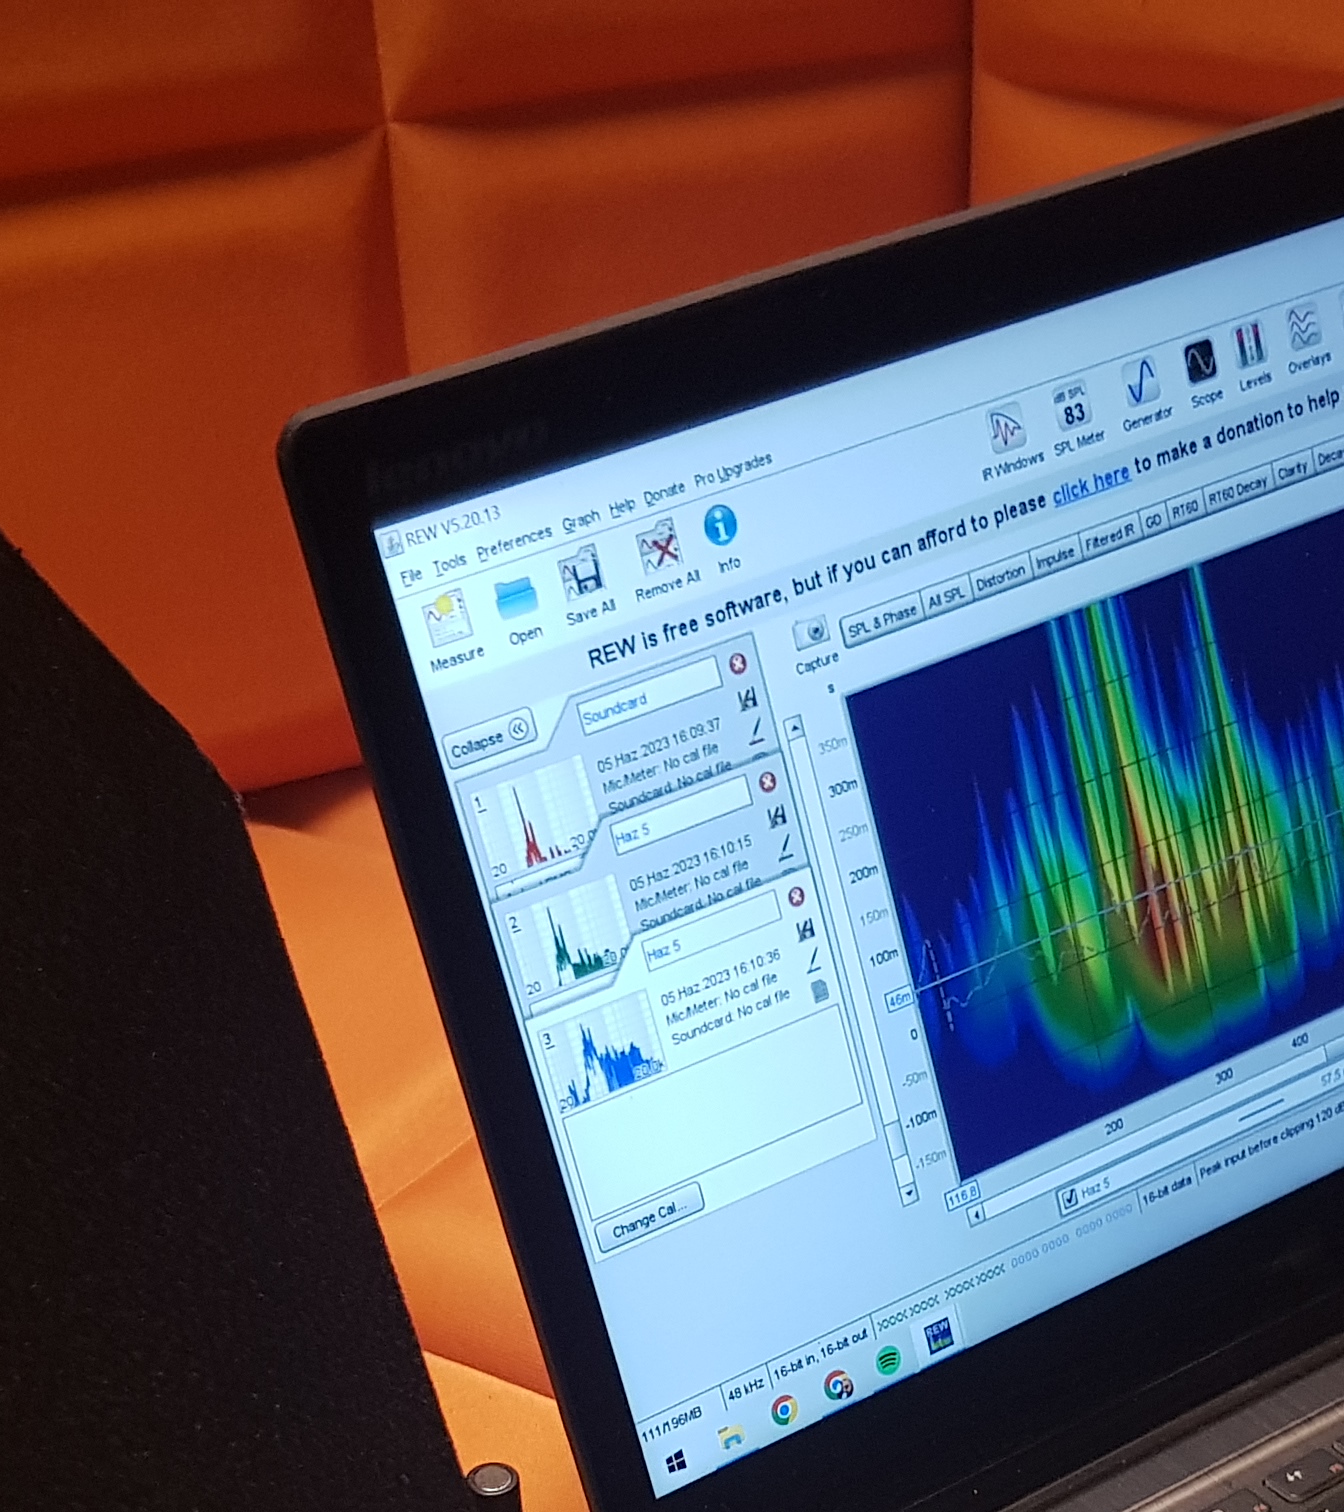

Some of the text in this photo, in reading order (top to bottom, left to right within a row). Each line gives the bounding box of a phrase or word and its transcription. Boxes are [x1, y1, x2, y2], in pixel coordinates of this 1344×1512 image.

[1287, 349, 1332, 377] Overlays
[1238, 369, 1273, 393] Levels
[1190, 386, 1224, 411] Scope
[1062, 401, 1086, 427] 83
[1121, 403, 1174, 433] Generator
[1053, 427, 1106, 457] SPL Meter
[693, 451, 773, 490] Pro Upgrades
[992, 448, 1045, 479] Windows
[1277, 459, 1309, 483] Clarity
[642, 480, 687, 507] Donate
[1207, 473, 1268, 507] RT60 Decay
[561, 508, 601, 534] Graph
[608, 496, 637, 518] Help
[1171, 498, 1199, 520] RT60
[404, 504, 502, 548] REW V5.20.13
[587, 634, 638, 670] REW
[640, 627, 659, 651] is
[661, 612, 700, 643] free
[702, 581, 789, 632] software,
[791, 569, 824, 598] but
[825, 562, 841, 585] if
[842, 553, 878, 584] you
[880, 540, 913, 566] can
[915, 518, 967, 554] afford
[969, 510, 990, 534] to
[992, 491, 1048, 530] please
[1050, 474, 1091, 508] click
[1091, 460, 1131, 494] here
[1133, 453, 1152, 475] to
[1155, 436, 1198, 467] make
[1202, 435, 1213, 451] a
[1214, 406, 1284, 446] donation
[1286, 399, 1304, 421] to
[1306, 386, 1341, 417] help
[1084, 526, 1123, 553] Filtered
[476, 524, 553, 562] Preferences
[432, 552, 468, 577] Tools
[717, 555, 742, 575] Info
[1035, 544, 1076, 572] Impulse
[399, 566, 424, 587] File
[634, 569, 701, 604] Remove All
[975, 561, 1027, 593] Distortion
[926, 583, 967, 611] All SPL
[565, 598, 617, 627] Save All
[847, 601, 917, 640] SPL & Phase
[508, 623, 544, 649] Open
[429, 643, 485, 674] Measure
[795, 649, 840, 678] Capture
[581, 691, 648, 728] Soundcard
[450, 728, 505, 762] Collapse
[662, 754, 681, 773] No
[681, 747, 701, 766] cal
[700, 740, 720, 759] file
[827, 777, 858, 798] 300m
[614, 822, 650, 847] Haz 5
[848, 862, 879, 884] 200m
[869, 946, 899, 968] 100m
[723, 985, 741, 1004] No
[741, 977, 760, 996] cal
[760, 969, 778, 988] file
[736, 1002, 755, 1020] No
[755, 994, 773, 1012] cal
[772, 986, 791, 1005] file
[1291, 1032, 1309, 1050] 400
[1215, 1067, 1233, 1085] 300
[1104, 1117, 1124, 1136] 200
[1199, 1159, 1222, 1180] Peak
[1223, 1147, 1246, 1170] input
[1247, 1132, 1278, 1157] before
[1278, 1115, 1314, 1144] clipping
[1315, 1105, 1333, 1124] 120
[1142, 1173, 1192, 1207] 16-bit data
[612, 1210, 657, 1241] Change
[773, 1326, 868, 1380] 16-bit in, 16-bit out
[727, 1376, 764, 1403] 48 kHz
[641, 1405, 702, 1445] 111/196MB
